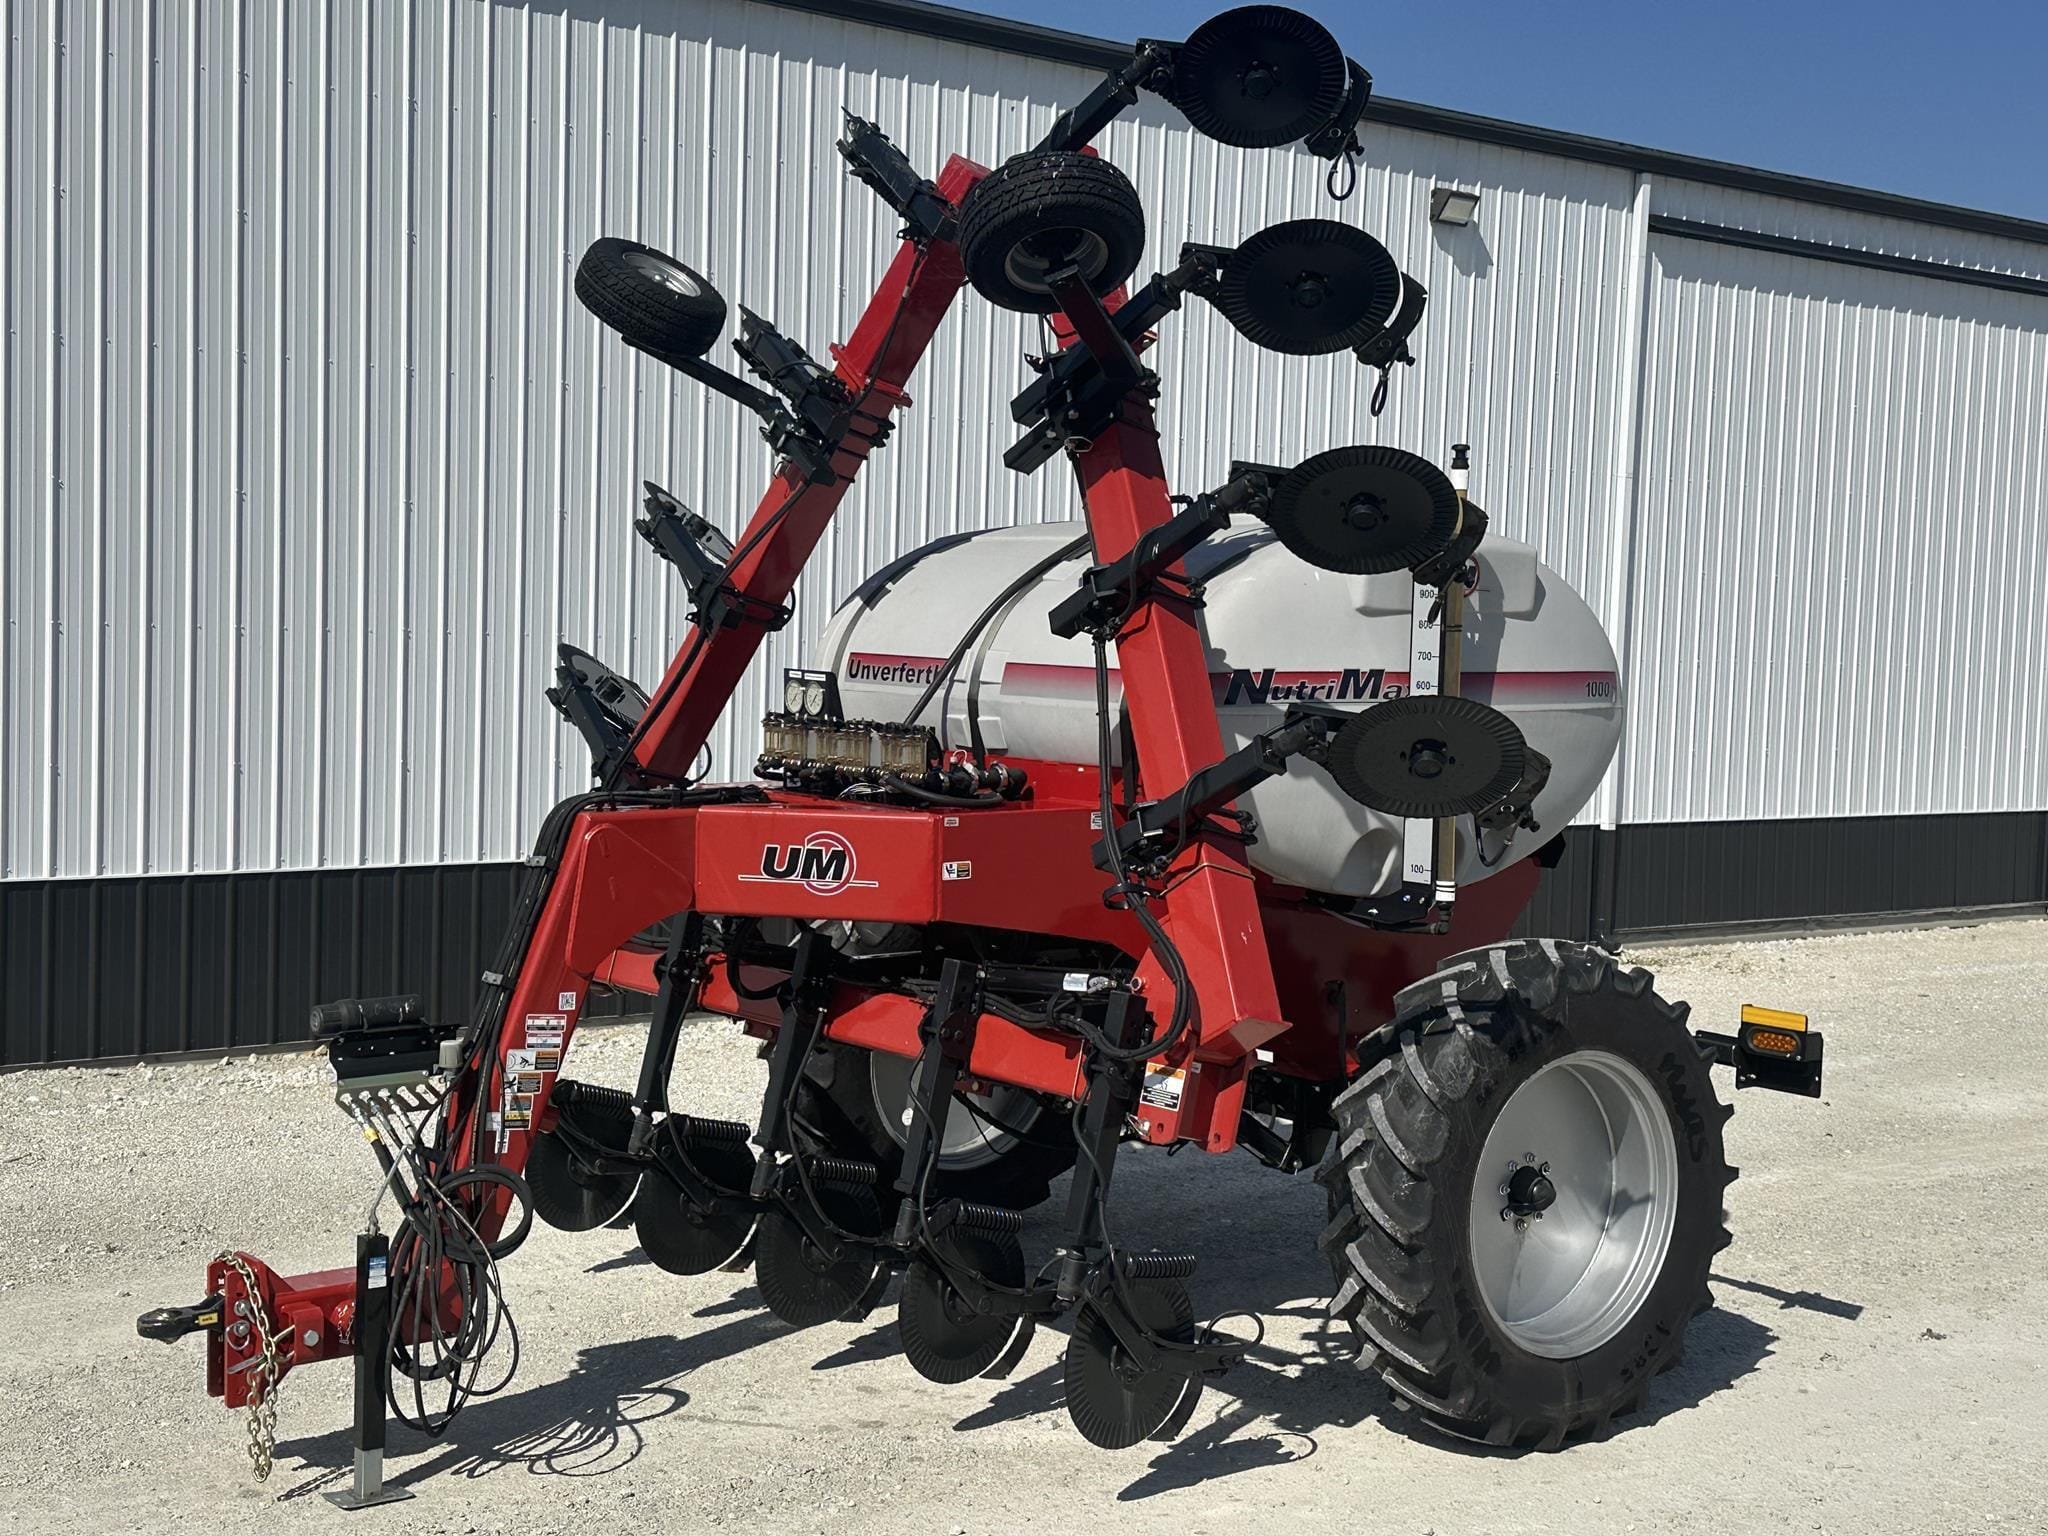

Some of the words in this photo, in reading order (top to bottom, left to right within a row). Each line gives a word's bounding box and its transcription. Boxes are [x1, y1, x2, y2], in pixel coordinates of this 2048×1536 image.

[1419, 589, 1435, 599] 900
[1418, 619, 1433, 630] 800
[1417, 651, 1432, 661] 700
[1224, 668, 1411, 704] NutriMa
[1415, 680, 1431, 691] 600
[1584, 681, 1610, 698] 1000
[761, 845, 848, 881] UM
[1410, 863, 1424, 874] 100
